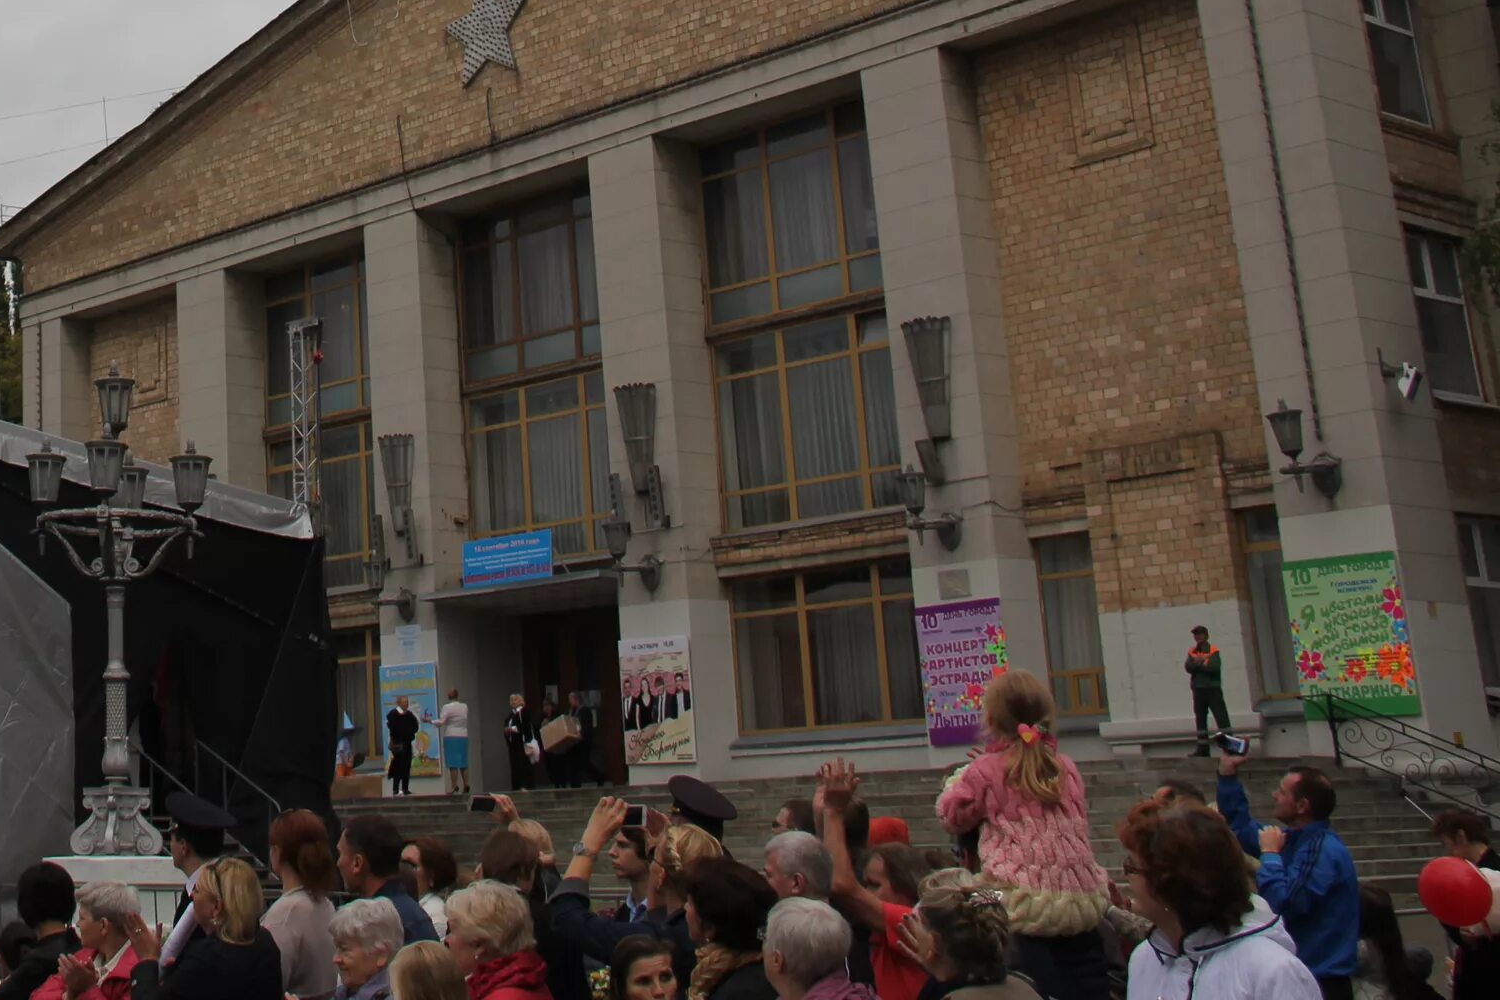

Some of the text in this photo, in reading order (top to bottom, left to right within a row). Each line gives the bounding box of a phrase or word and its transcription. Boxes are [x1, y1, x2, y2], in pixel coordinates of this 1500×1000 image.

[1292, 567, 1311, 585] 10
[921, 614, 938, 629] 10
[1301, 604, 1315, 630] Я
[926, 639, 987, 655] КОНЦЕРТ
[929, 654, 997, 670] АРТИСТОВ
[930, 670, 993, 686] ЭСТРАДЫ
